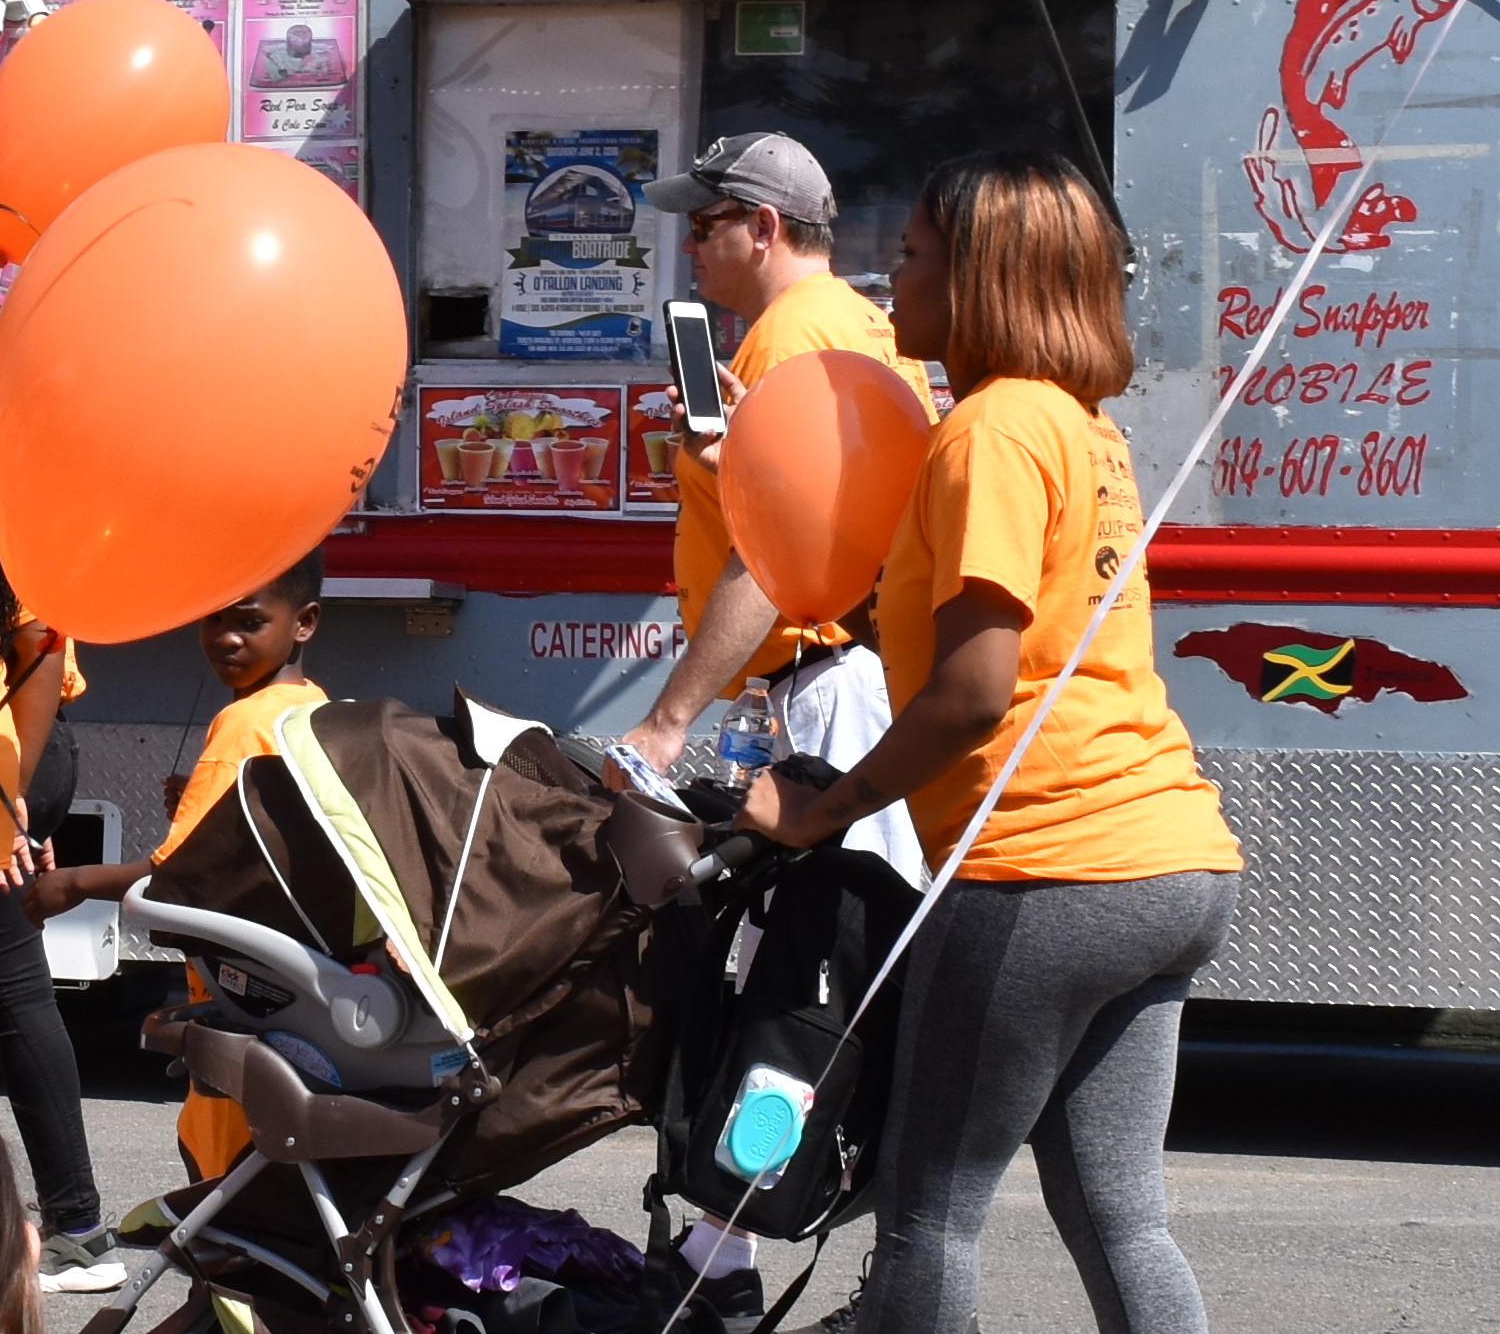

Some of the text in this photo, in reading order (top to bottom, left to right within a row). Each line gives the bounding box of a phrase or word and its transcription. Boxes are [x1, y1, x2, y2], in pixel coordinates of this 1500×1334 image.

[259, 98, 283, 113] Red
[285, 98, 307, 113] Pea
[281, 118, 300, 133] Cole
[572, 241, 631, 260] BOATRIDE
[533, 276, 623, 291] O'FALLON LANDING
[1217, 284, 1430, 349] Red Snapper
[1219, 359, 1433, 406] MOBILE
[436, 399, 603, 428] Island Splash Smoothies
[643, 402, 672, 419] Isla
[530, 621, 663, 659] CATERING
